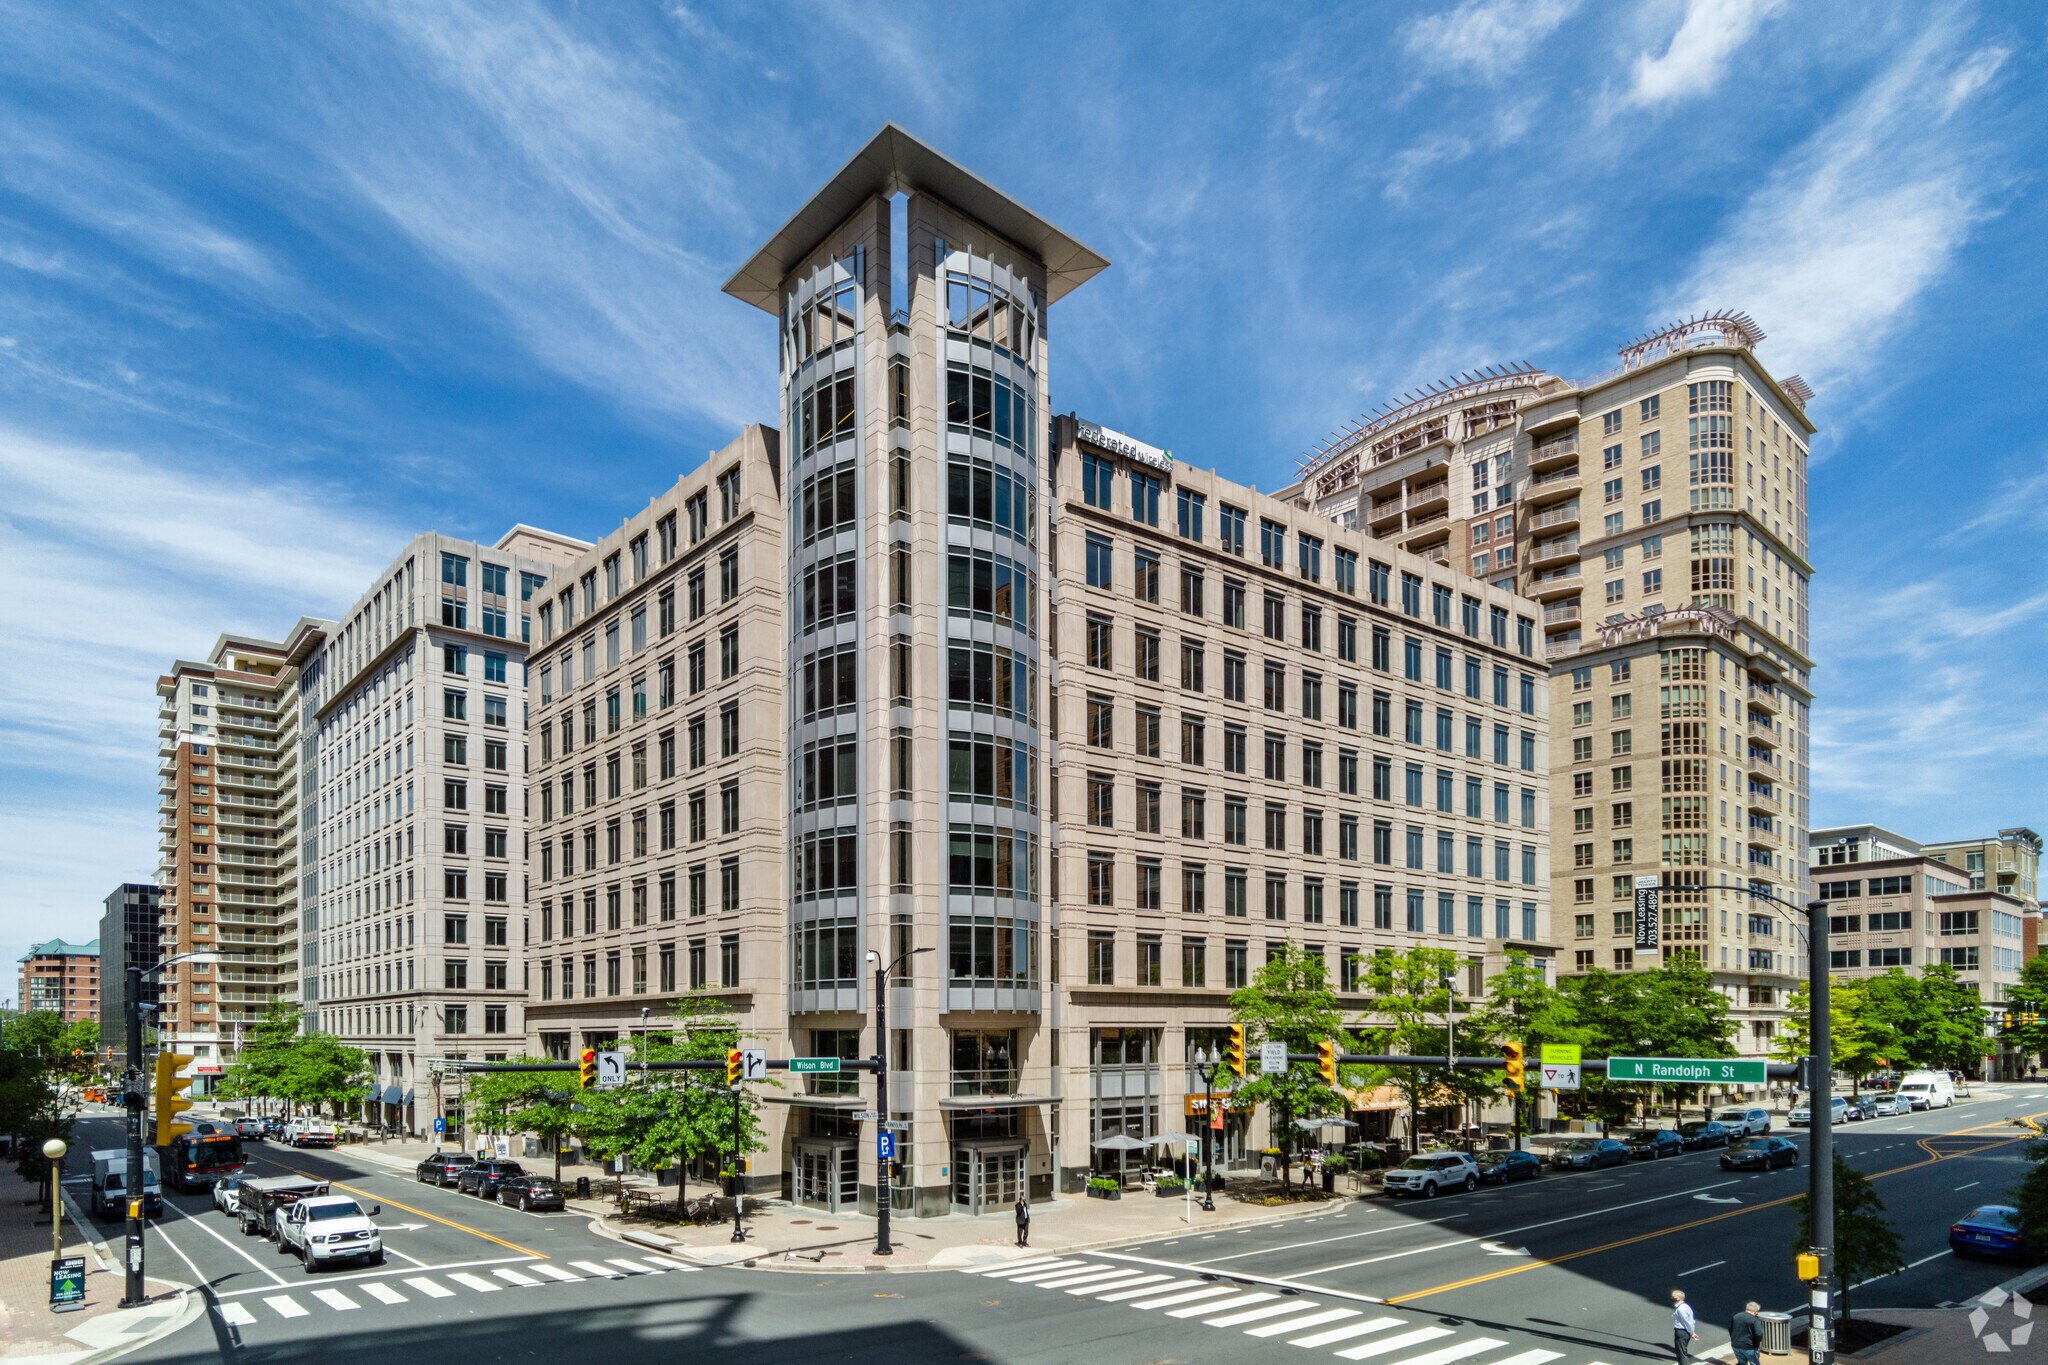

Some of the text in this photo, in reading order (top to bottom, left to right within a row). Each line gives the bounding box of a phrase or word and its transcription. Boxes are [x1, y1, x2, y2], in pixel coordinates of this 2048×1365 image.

[1080, 423, 1174, 471] federated wireless
[1636, 889, 1648, 944] Now Leasing
[796, 1061, 834, 1070] Wilson Blvd
[1635, 1063, 1735, 1079] N Randolph St
[435, 1120, 442, 1129] P
[881, 1136, 889, 1152] P
[55, 1273, 82, 1281] LEASING
